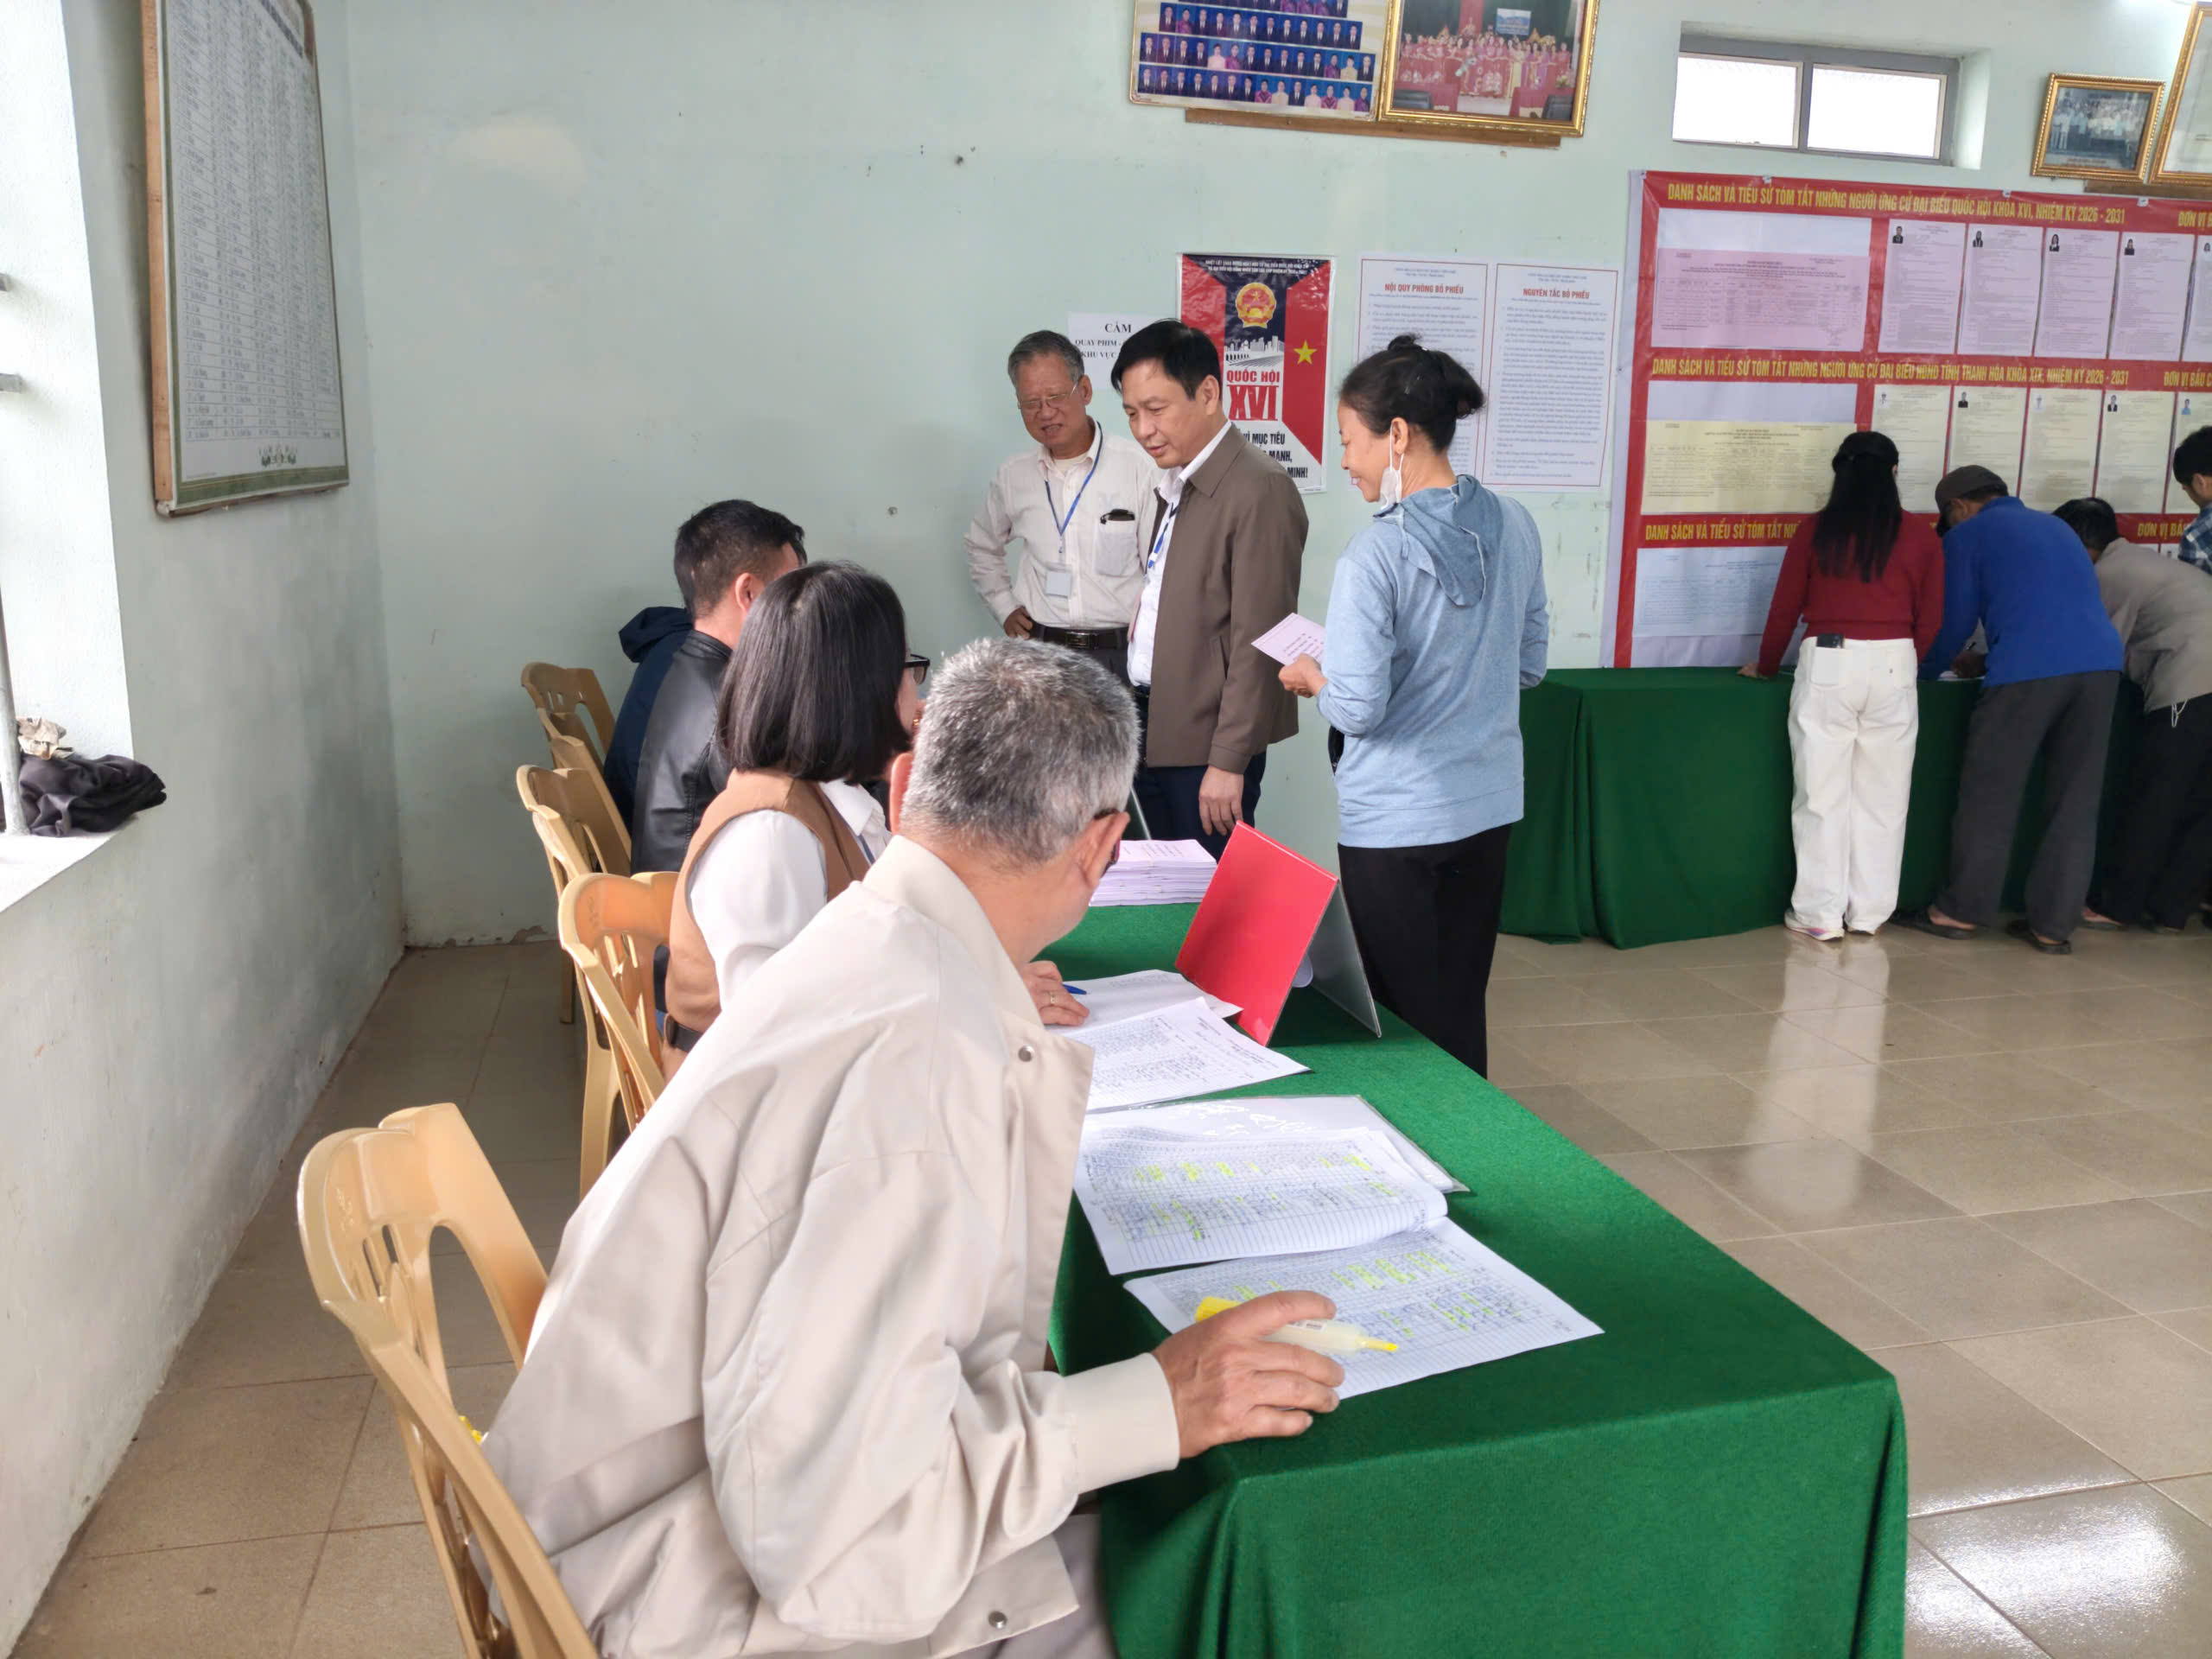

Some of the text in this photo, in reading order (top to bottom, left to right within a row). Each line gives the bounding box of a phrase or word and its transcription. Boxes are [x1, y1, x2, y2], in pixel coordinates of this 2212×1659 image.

[1669, 183, 1694, 200] DANH
[1697, 181, 1721, 202] SÁCH
[1725, 182, 1736, 202] VÀ
[2077, 207, 2099, 222] 2026
[2105, 207, 2125, 224] 2031
[1226, 367, 1280, 385] QUỐC HỘI
[1652, 359, 1676, 374] DANH
[1679, 356, 1702, 375] SÁCH
[1705, 356, 1715, 375] VÀ
[2085, 369, 2104, 385] 2026
[2110, 371, 2129, 385] 2031
[1226, 385, 1279, 421] XVI
[1252, 433, 1268, 448] MỤC
[1270, 431, 1286, 445] TIÊU
[1287, 467, 1308, 478] MINH!
[1645, 524, 1669, 540] DANH
[1671, 521, 1694, 539] SÁCH
[1696, 521, 1707, 539] VÀ
